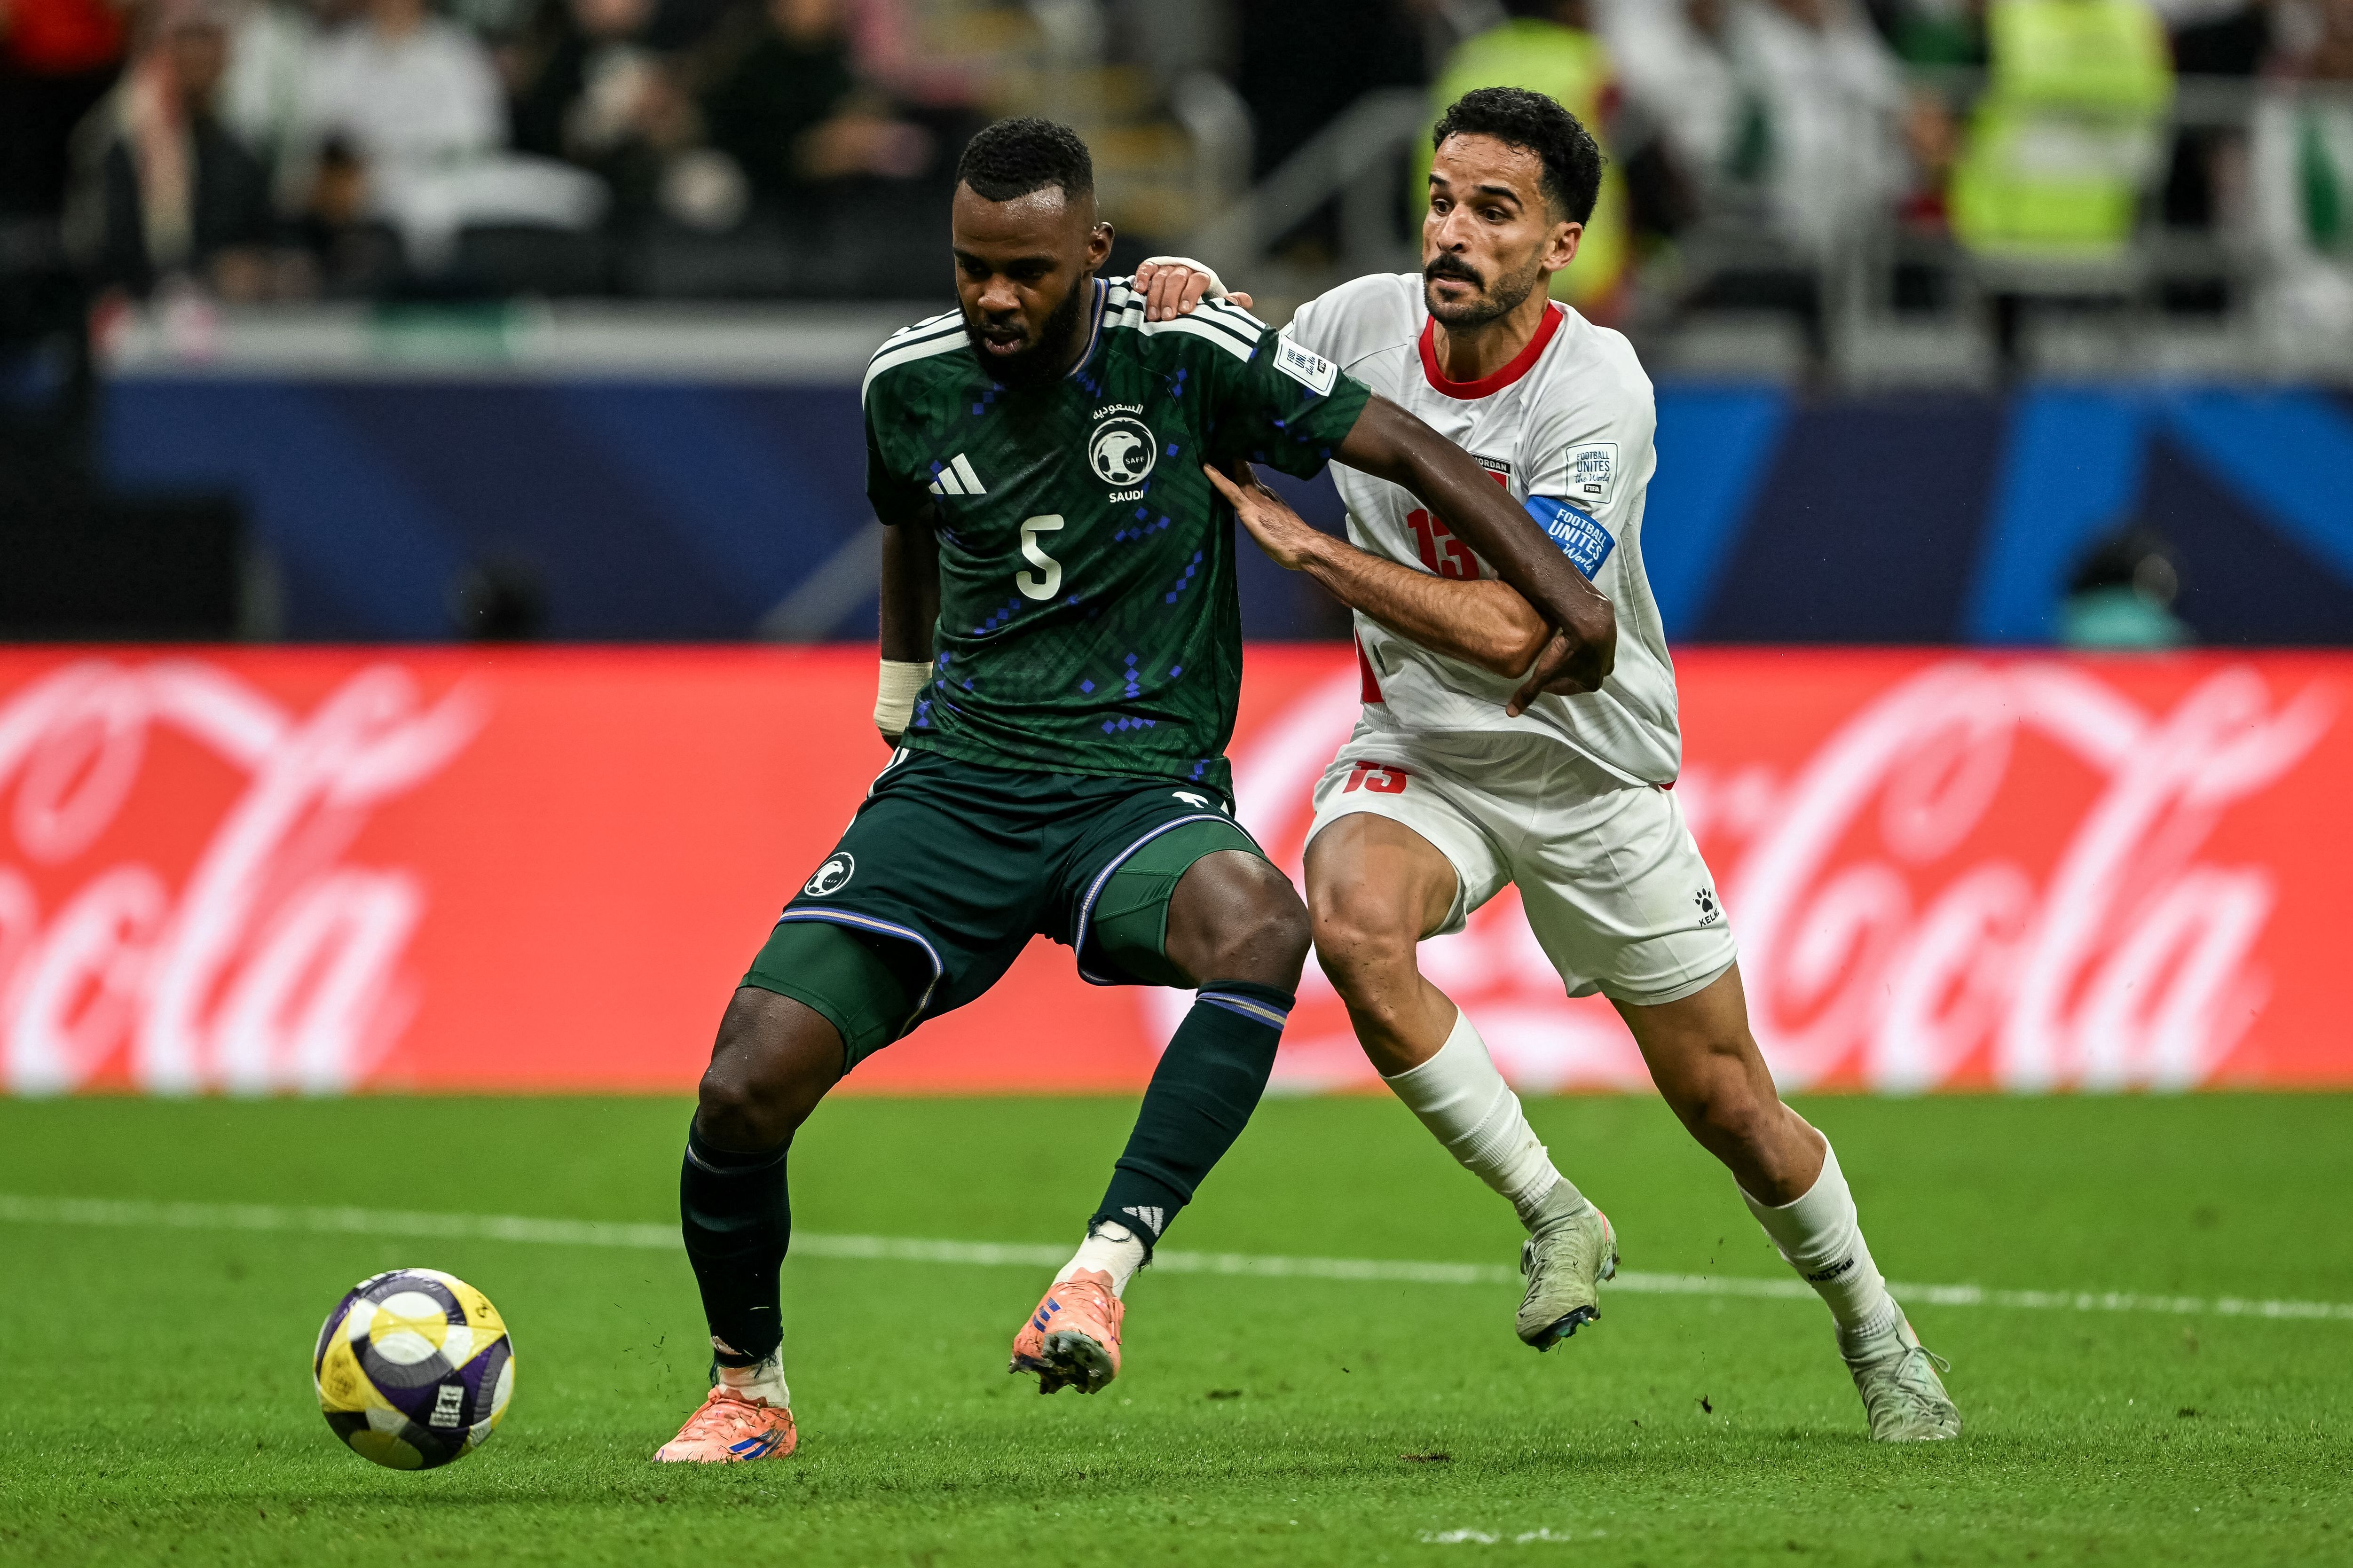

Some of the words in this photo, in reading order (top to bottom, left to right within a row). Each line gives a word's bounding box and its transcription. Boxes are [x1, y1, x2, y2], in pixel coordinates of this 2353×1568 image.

[1287, 348, 1296, 363] FOOT
[1294, 353, 1306, 368] UNI
[1125, 456, 1144, 464] SAFF
[1577, 451, 1610, 461] FOOTBALL
[1576, 461, 1610, 472] UNITES
[1109, 489, 1143, 503] SAUDI
[1556, 508, 1606, 548] FOOTBALL
[1407, 509, 1479, 581] 13
[1548, 519, 1602, 560] UNITES
[1016, 514, 1064, 600] 5
[1563, 543, 1595, 574] World
